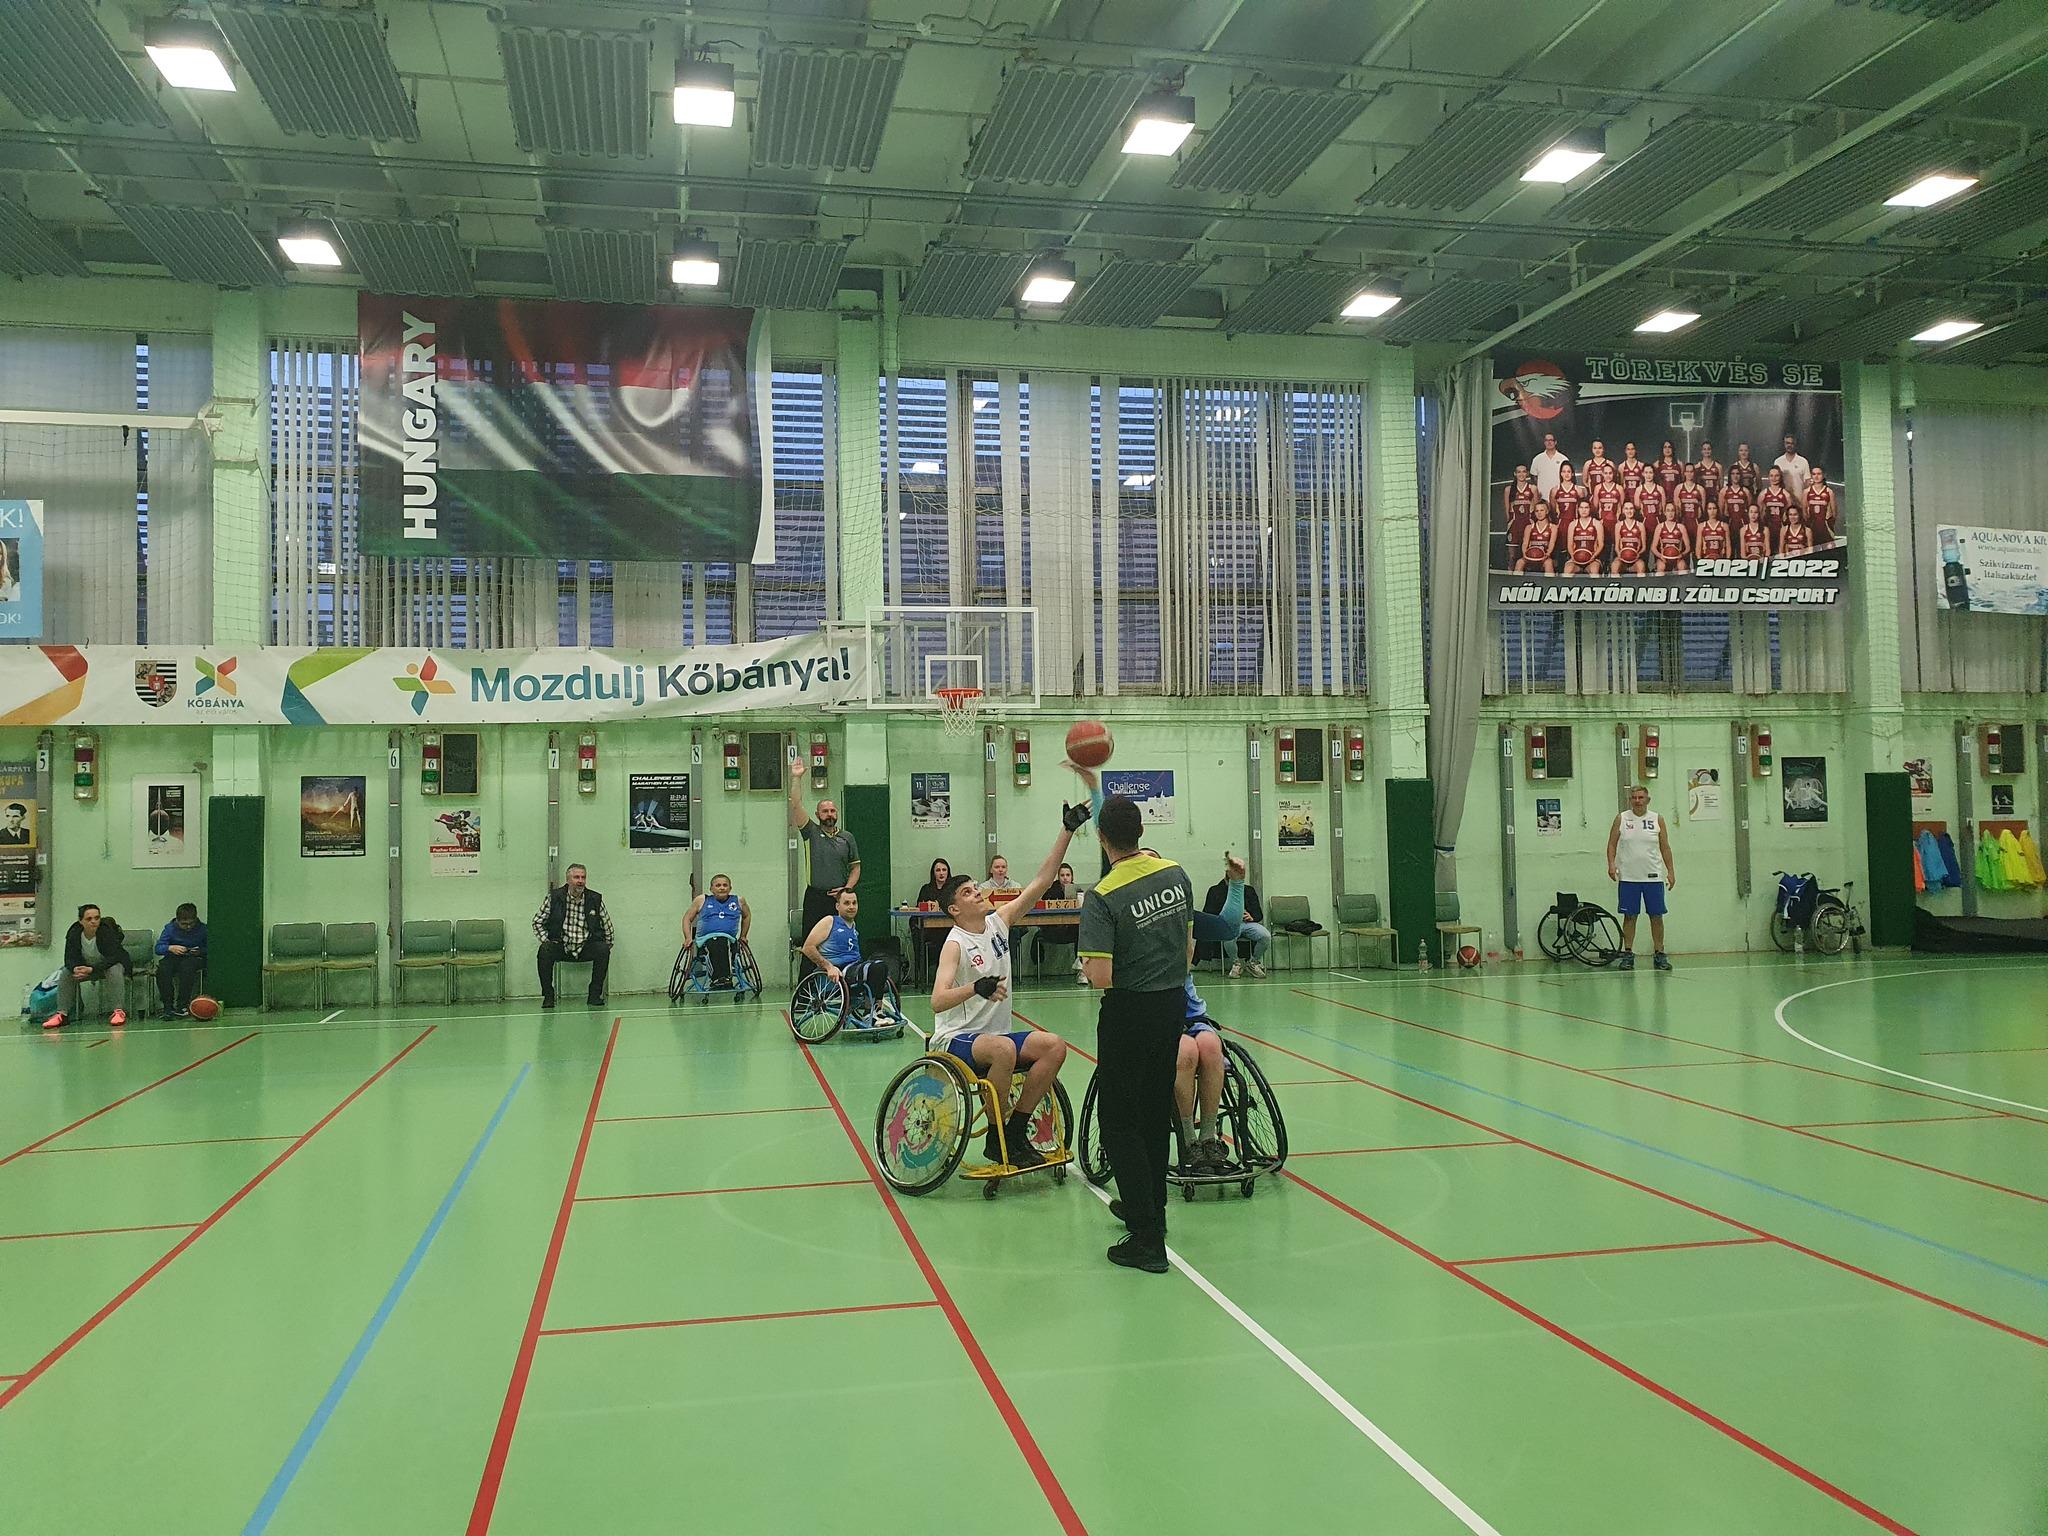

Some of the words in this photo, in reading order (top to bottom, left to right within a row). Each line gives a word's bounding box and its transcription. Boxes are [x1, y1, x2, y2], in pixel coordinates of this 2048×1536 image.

[1585, 352, 1769, 385] TÖREKVÉS
[1782, 363, 1823, 387] SE
[402, 310, 438, 540] HUNGARY
[1499, 581, 1543, 603] NŐI
[1543, 582, 1636, 603] AMATŐR
[1636, 586, 1669, 603] NB
[1684, 583, 1740, 603] ZÖLD
[1741, 587, 1839, 603] CSOPORT
[470, 665, 645, 706] Mozdulj
[658, 647, 852, 698] Kőbánya!
[187, 697, 245, 708] KŐBÁNYA
[693, 746, 700, 762] 8
[789, 747, 796, 760] 9
[987, 744, 996, 760] 10
[1251, 743, 1258, 758] 11
[1333, 741, 1340, 757] 12
[1353, 750, 1361, 759] 12
[39, 752, 46, 769] 5
[391, 749, 397, 767] 6
[551, 751, 557, 767] 7
[729, 758, 736, 766] 8
[816, 757, 822, 766] 9
[1019, 754, 1028, 762] 10
[1283, 752, 1290, 760] 11
[81, 763, 87, 772] 5
[428, 760, 435, 768] 6
[584, 759, 590, 768] 7
[1108, 782, 1150, 792] Challenge
[1642, 820, 1655, 830] 15
[1130, 884, 1186, 918] UNION
[718, 911, 725, 919] C
[848, 938, 853, 951] 5
